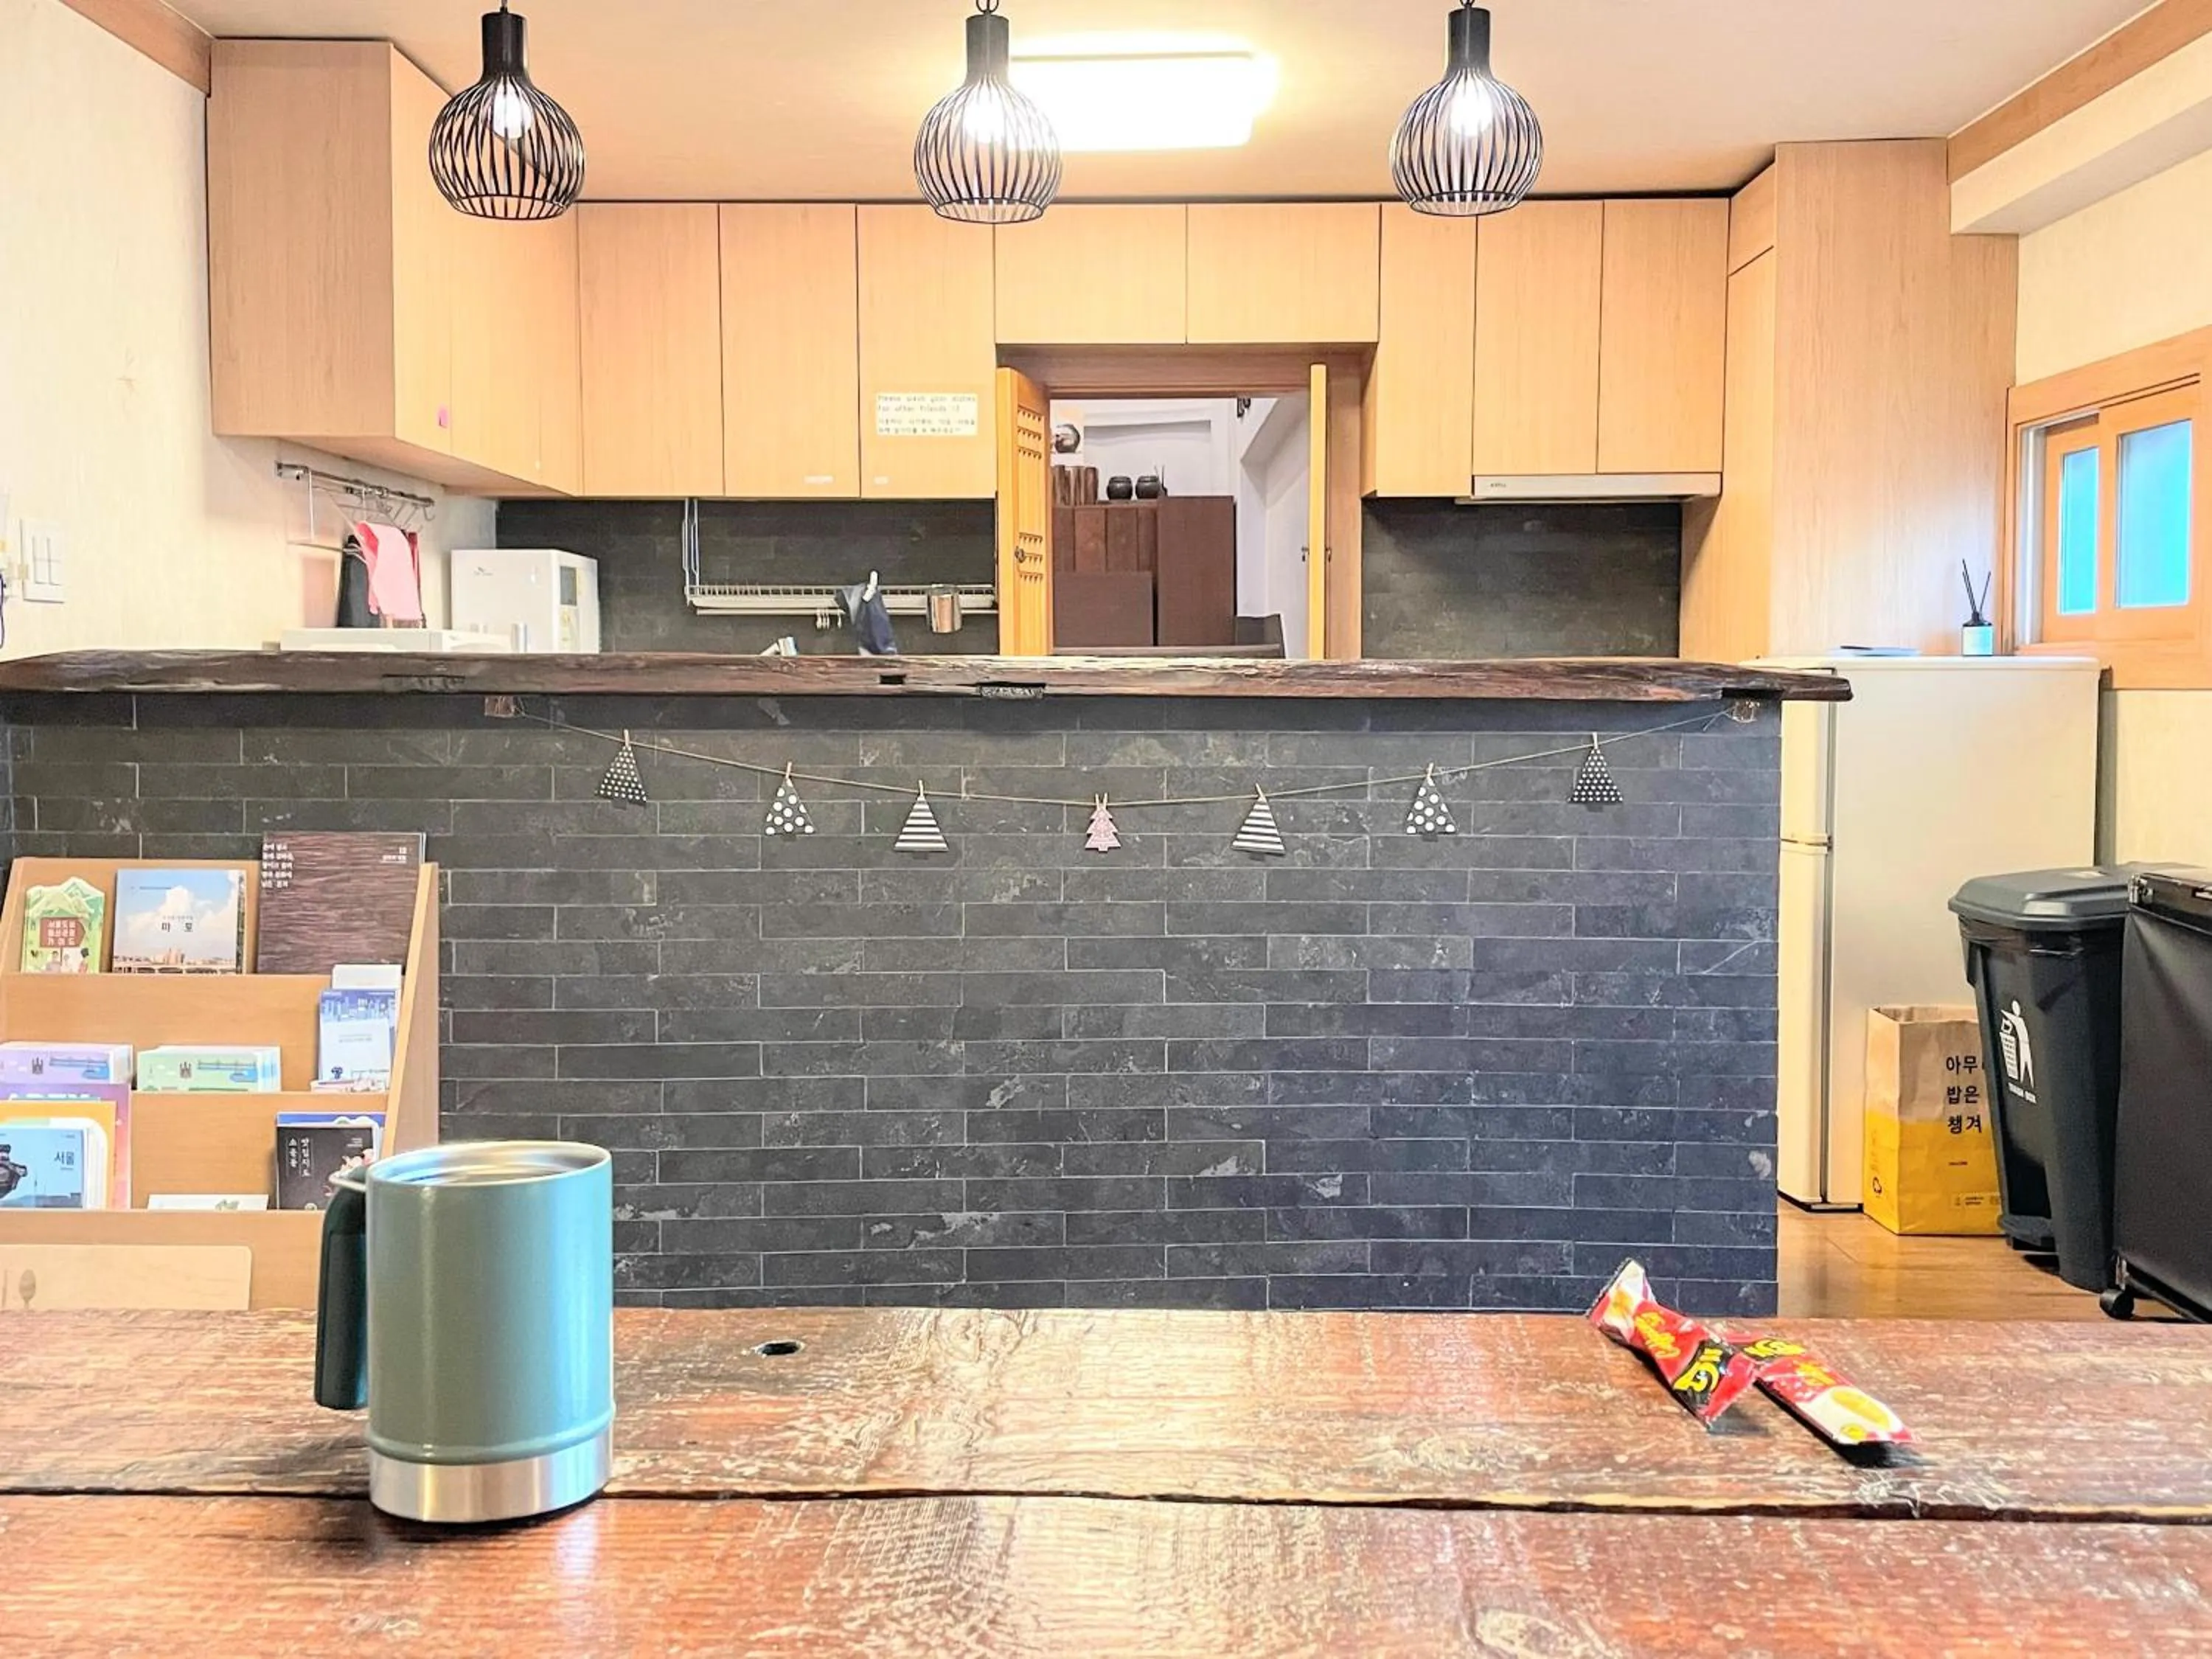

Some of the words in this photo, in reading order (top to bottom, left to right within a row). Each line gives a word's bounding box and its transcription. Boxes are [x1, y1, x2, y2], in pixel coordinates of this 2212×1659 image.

[1946, 1055, 1985, 1075] 아무
[1946, 1085, 1980, 1105] 밥은
[1947, 1114, 1983, 1135] 챙겨
[54, 1151, 74, 1166] 서울
